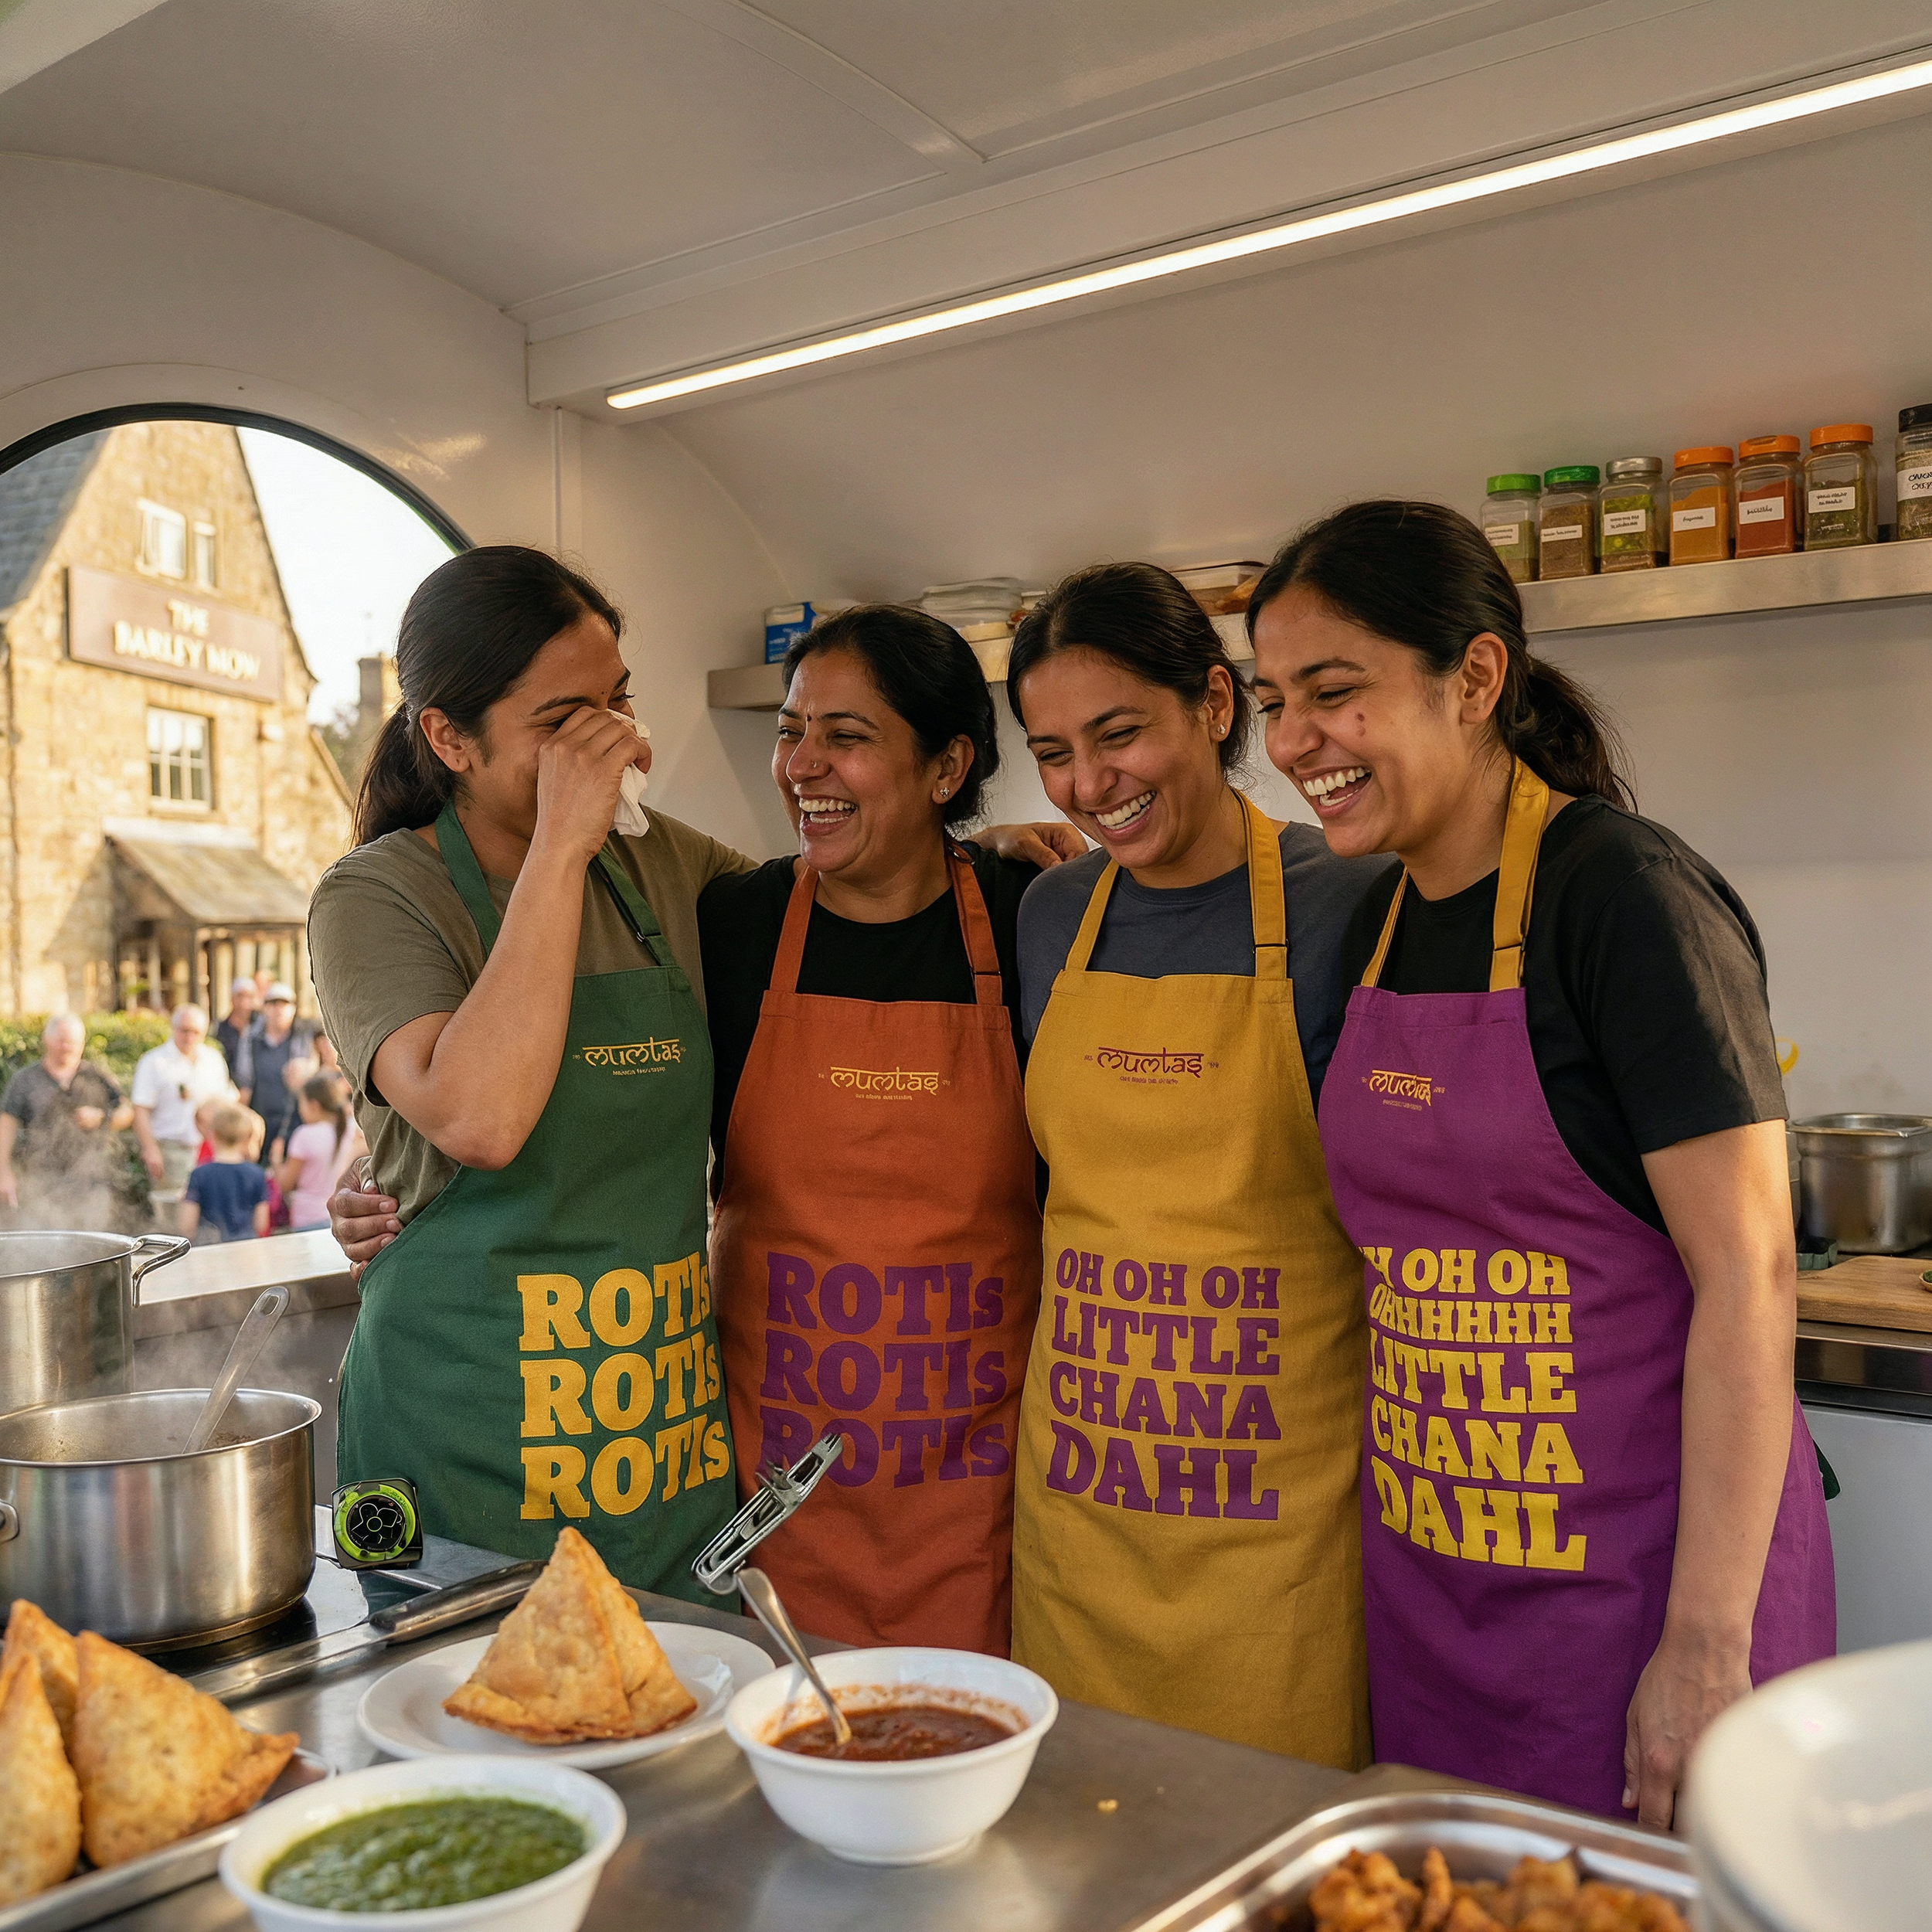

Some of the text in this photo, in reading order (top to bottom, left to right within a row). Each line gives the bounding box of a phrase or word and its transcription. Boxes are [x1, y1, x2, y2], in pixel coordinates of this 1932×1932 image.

[1056, 1248, 1281, 1309] OH OH OH
[1402, 1247, 1476, 1294] OH
[1487, 1249, 1570, 1295] OH
[1052, 1294, 1280, 1376] LITTLE
[1369, 1283, 1573, 1343] OHHHHHH
[1049, 1361, 1281, 1440] CHANA
[1369, 1326, 1577, 1413] LITTLE
[1046, 1420, 1279, 1520] DAHL
[1372, 1395, 1583, 1484] CHANA
[1371, 1455, 1587, 1571] DAHL
